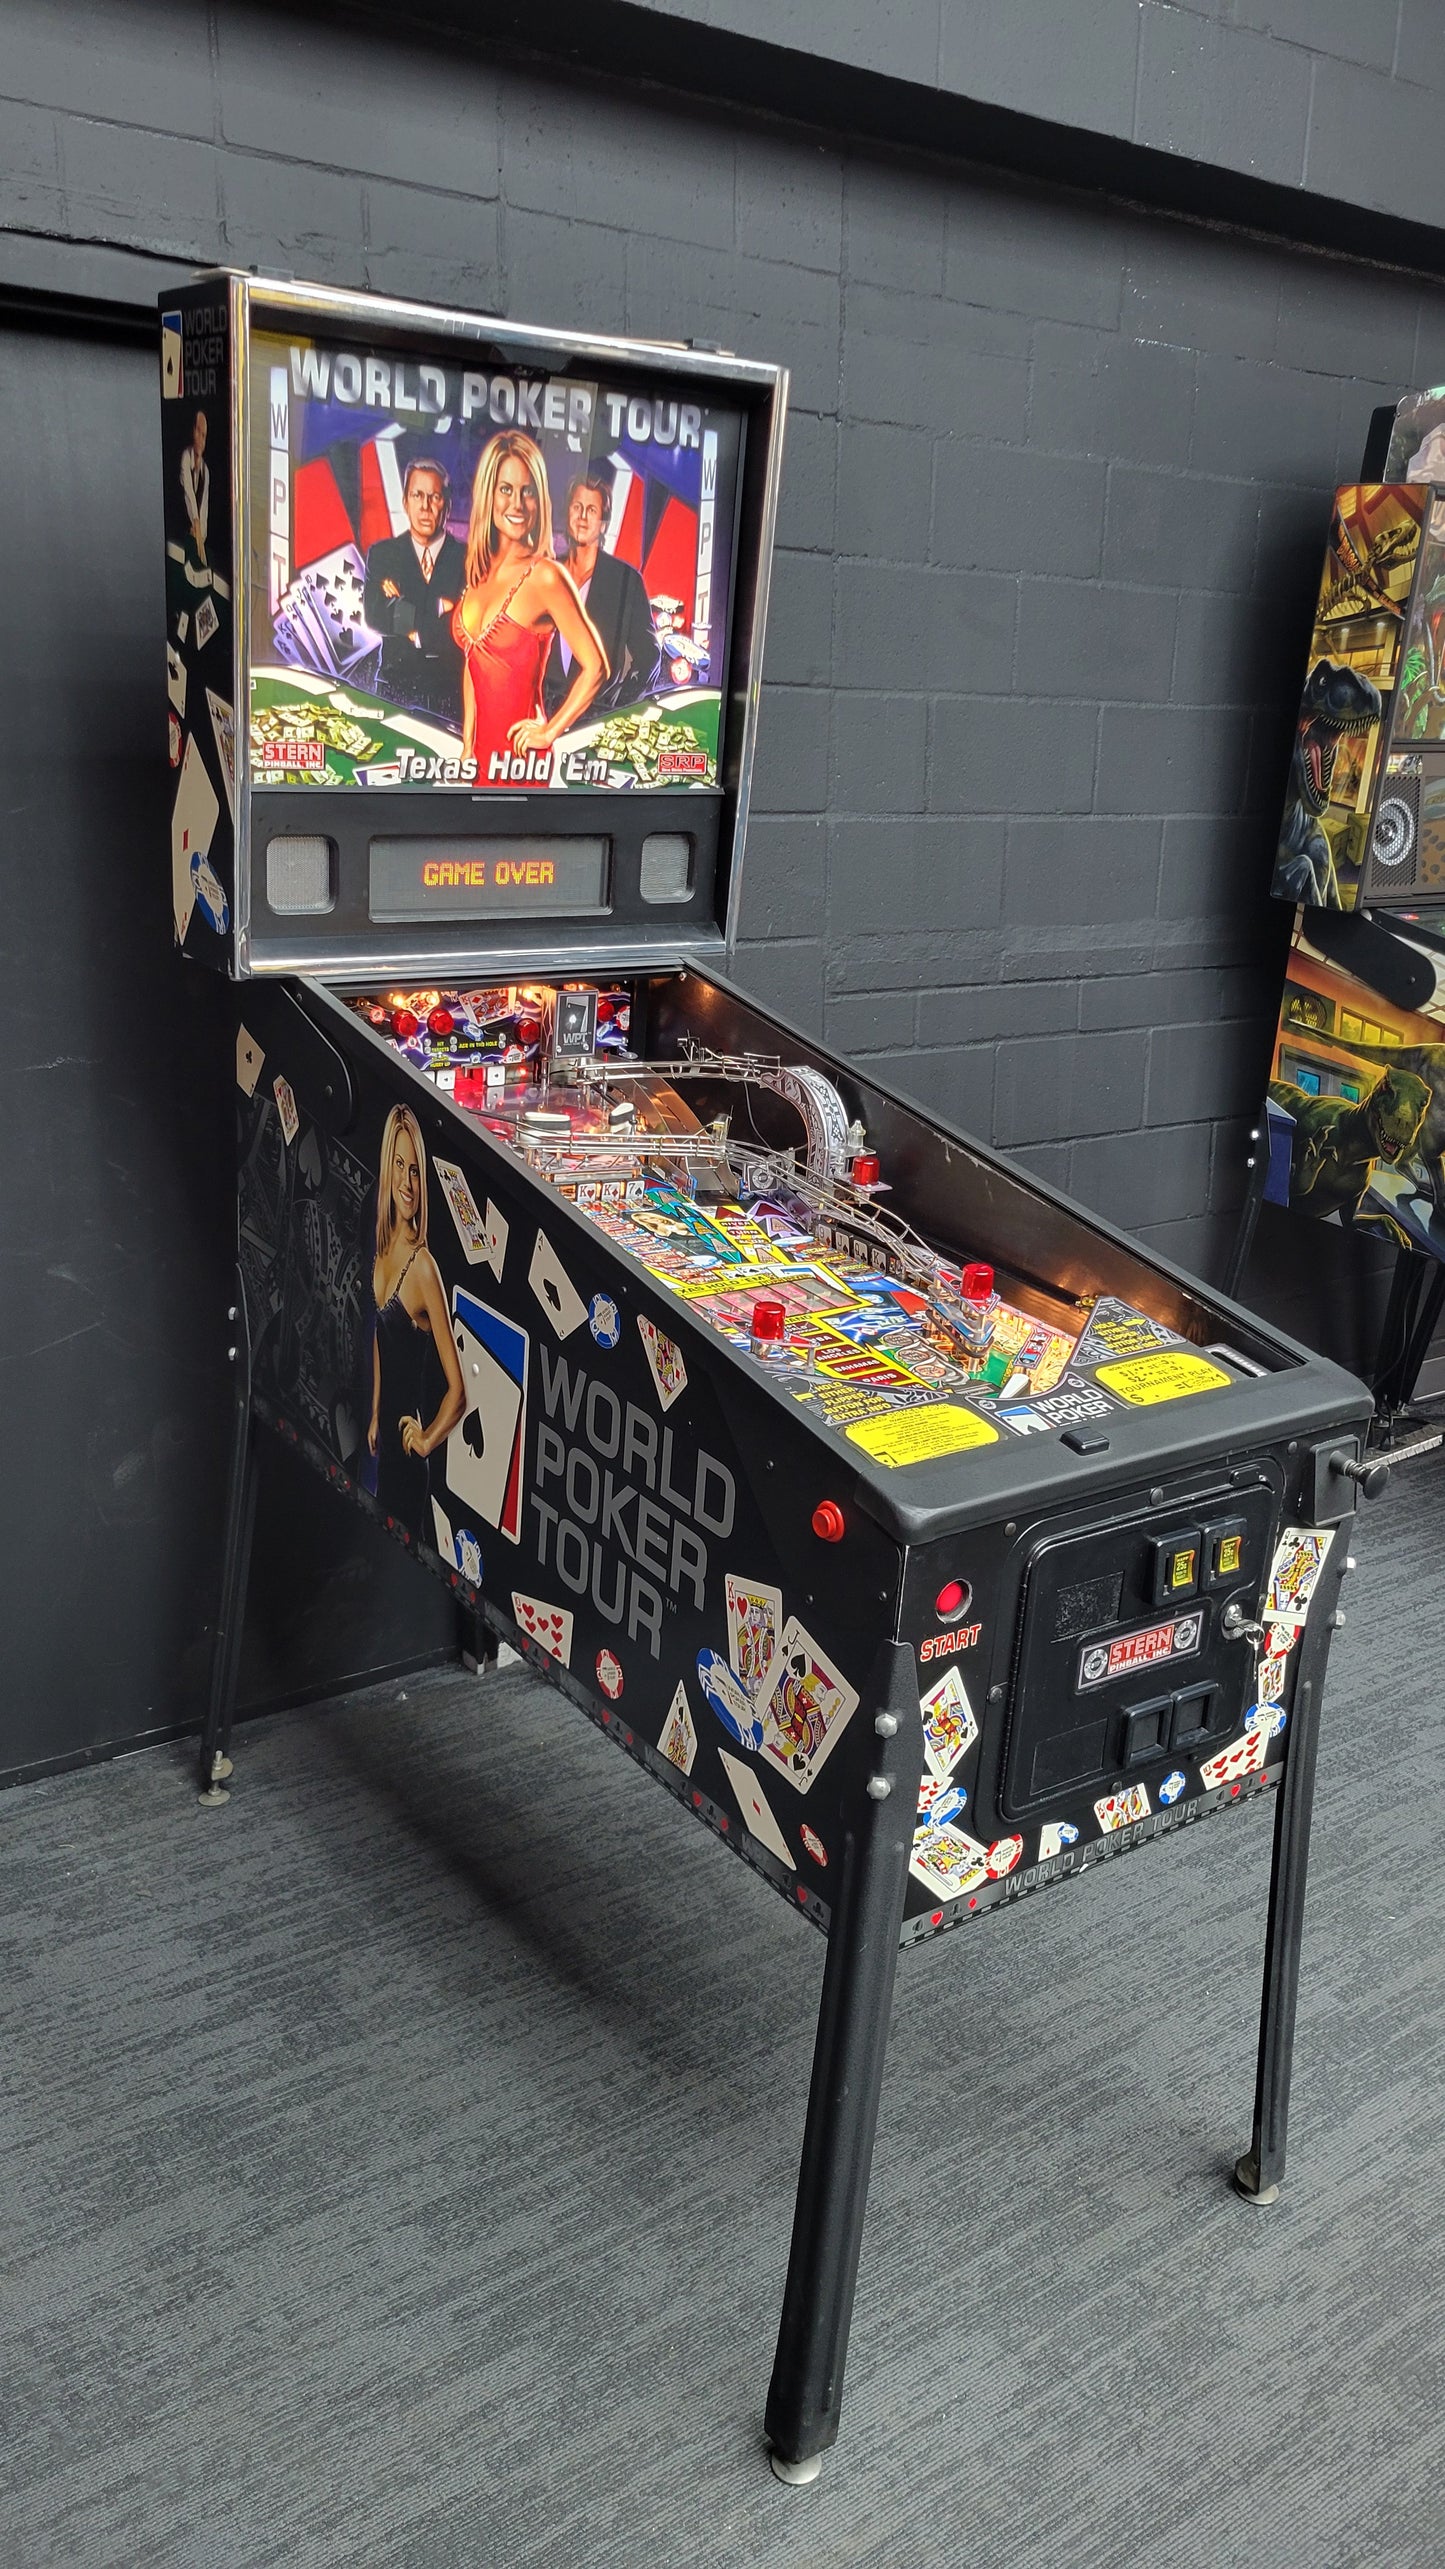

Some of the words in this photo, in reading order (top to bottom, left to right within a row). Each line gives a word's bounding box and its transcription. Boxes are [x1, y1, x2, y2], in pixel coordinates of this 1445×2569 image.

[184, 305, 227, 337] WORLD
[185, 337, 224, 368] POKER
[186, 369, 217, 395] TOUR
[289, 346, 446, 413] WORLD
[462, 372, 592, 434] POKER
[606, 392, 701, 448] TOUR
[264, 743, 321, 761] STERN
[396, 747, 477, 781] Texas
[488, 750, 552, 782] Hold
[661, 755, 705, 769] SRP
[423, 861, 485, 887] GAME
[495, 861, 555, 885] OVER
[563, 1032, 588, 1044] WPT
[579, 1185, 587, 1197] K
[604, 1184, 612, 1196] K
[628, 1182, 636, 1195] 7
[1092, 1321, 1117, 1330] HOLD
[816, 1349, 862, 1363] ANGELES
[821, 1347, 843, 1356] LOS
[833, 1359, 881, 1373] BAHAMAS
[814, 1381, 843, 1392] HOLD
[862, 1372, 898, 1384] PARIS
[1119, 1373, 1188, 1394] TOURNAMENT
[1189, 1367, 1214, 1378] PLAY
[818, 1386, 856, 1399] EITHER
[824, 1392, 867, 1406] FLIPPER
[1030, 1389, 1104, 1413] WORLD
[823, 1401, 864, 1415] BUTTON
[864, 1396, 885, 1405] FOR
[832, 1409, 866, 1421] EXTRA
[867, 1402, 892, 1413] INFO
[1046, 1400, 1115, 1424] POKER
[540, 1343, 736, 1539] WORLD
[536, 1421, 708, 1612] POKER
[531, 1492, 664, 1661] TOUR
[727, 1580, 735, 1599] K
[919, 1622, 983, 1663] START
[1111, 1627, 1172, 1664] STERN
[1005, 1852, 1075, 1896] WORLD
[1082, 1822, 1144, 1862] POKER
[1152, 1800, 1199, 1831] TOUR
